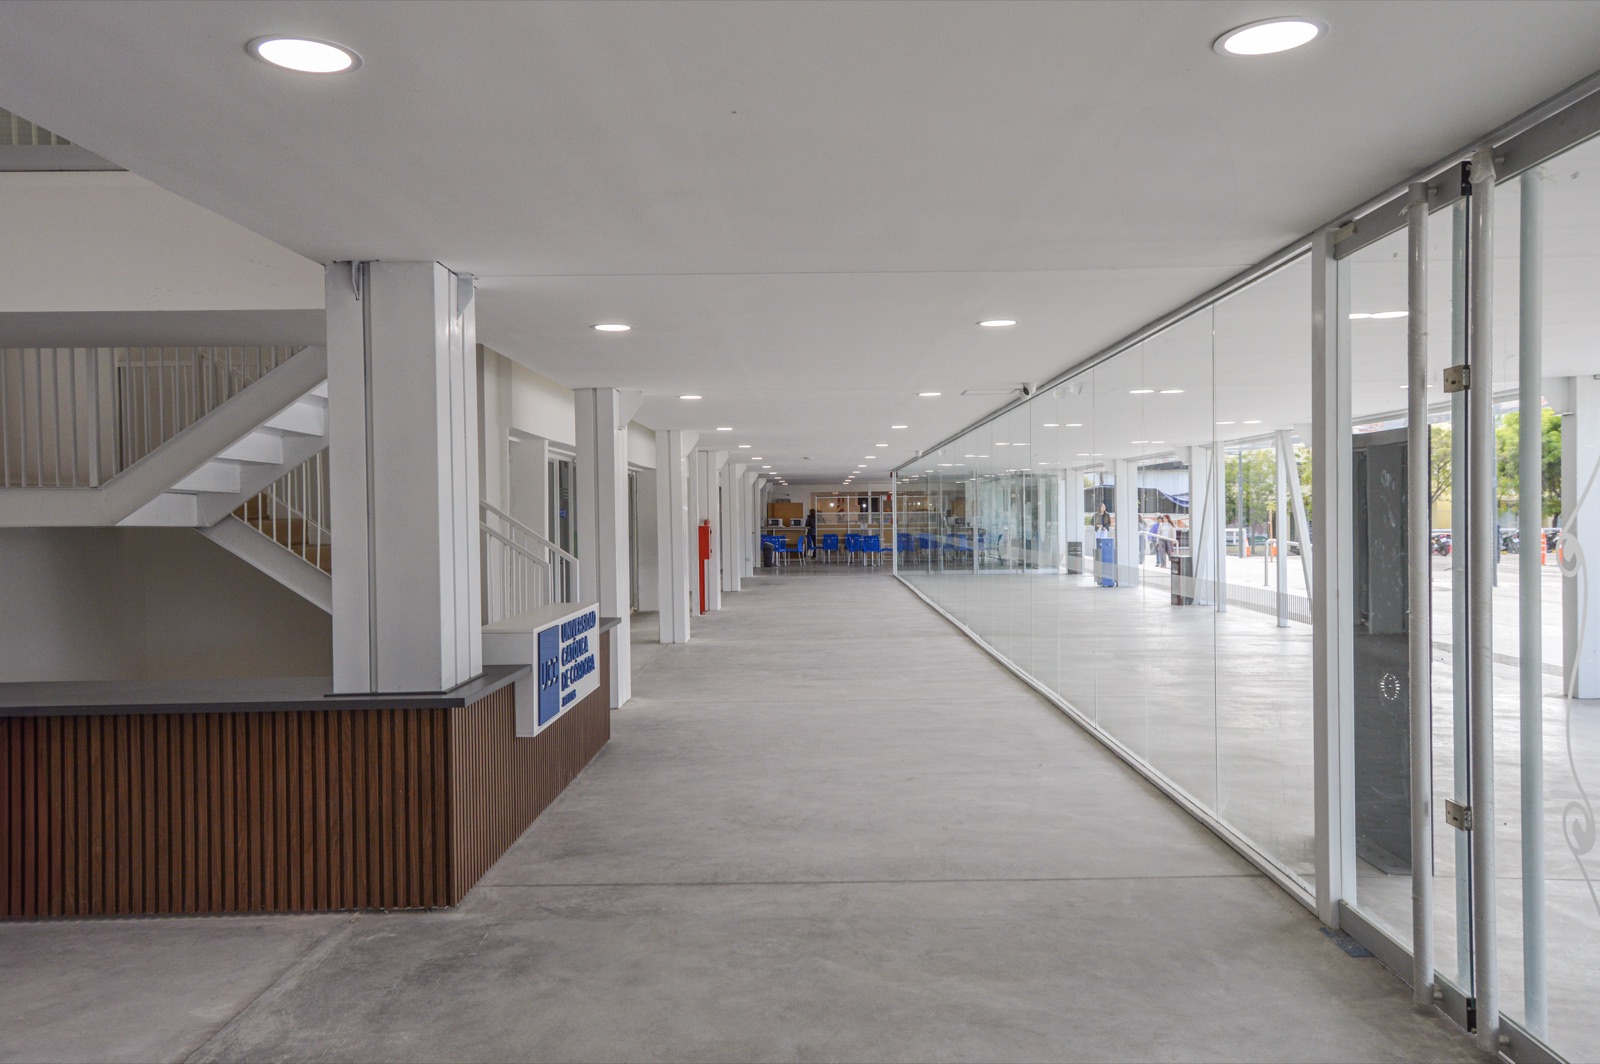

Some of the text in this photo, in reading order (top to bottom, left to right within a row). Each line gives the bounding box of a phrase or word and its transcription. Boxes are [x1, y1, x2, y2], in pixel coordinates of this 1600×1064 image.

[561, 611, 596, 642] UNIVERSIDAD
[541, 656, 559, 690] UCC
[561, 669, 570, 691] DE
